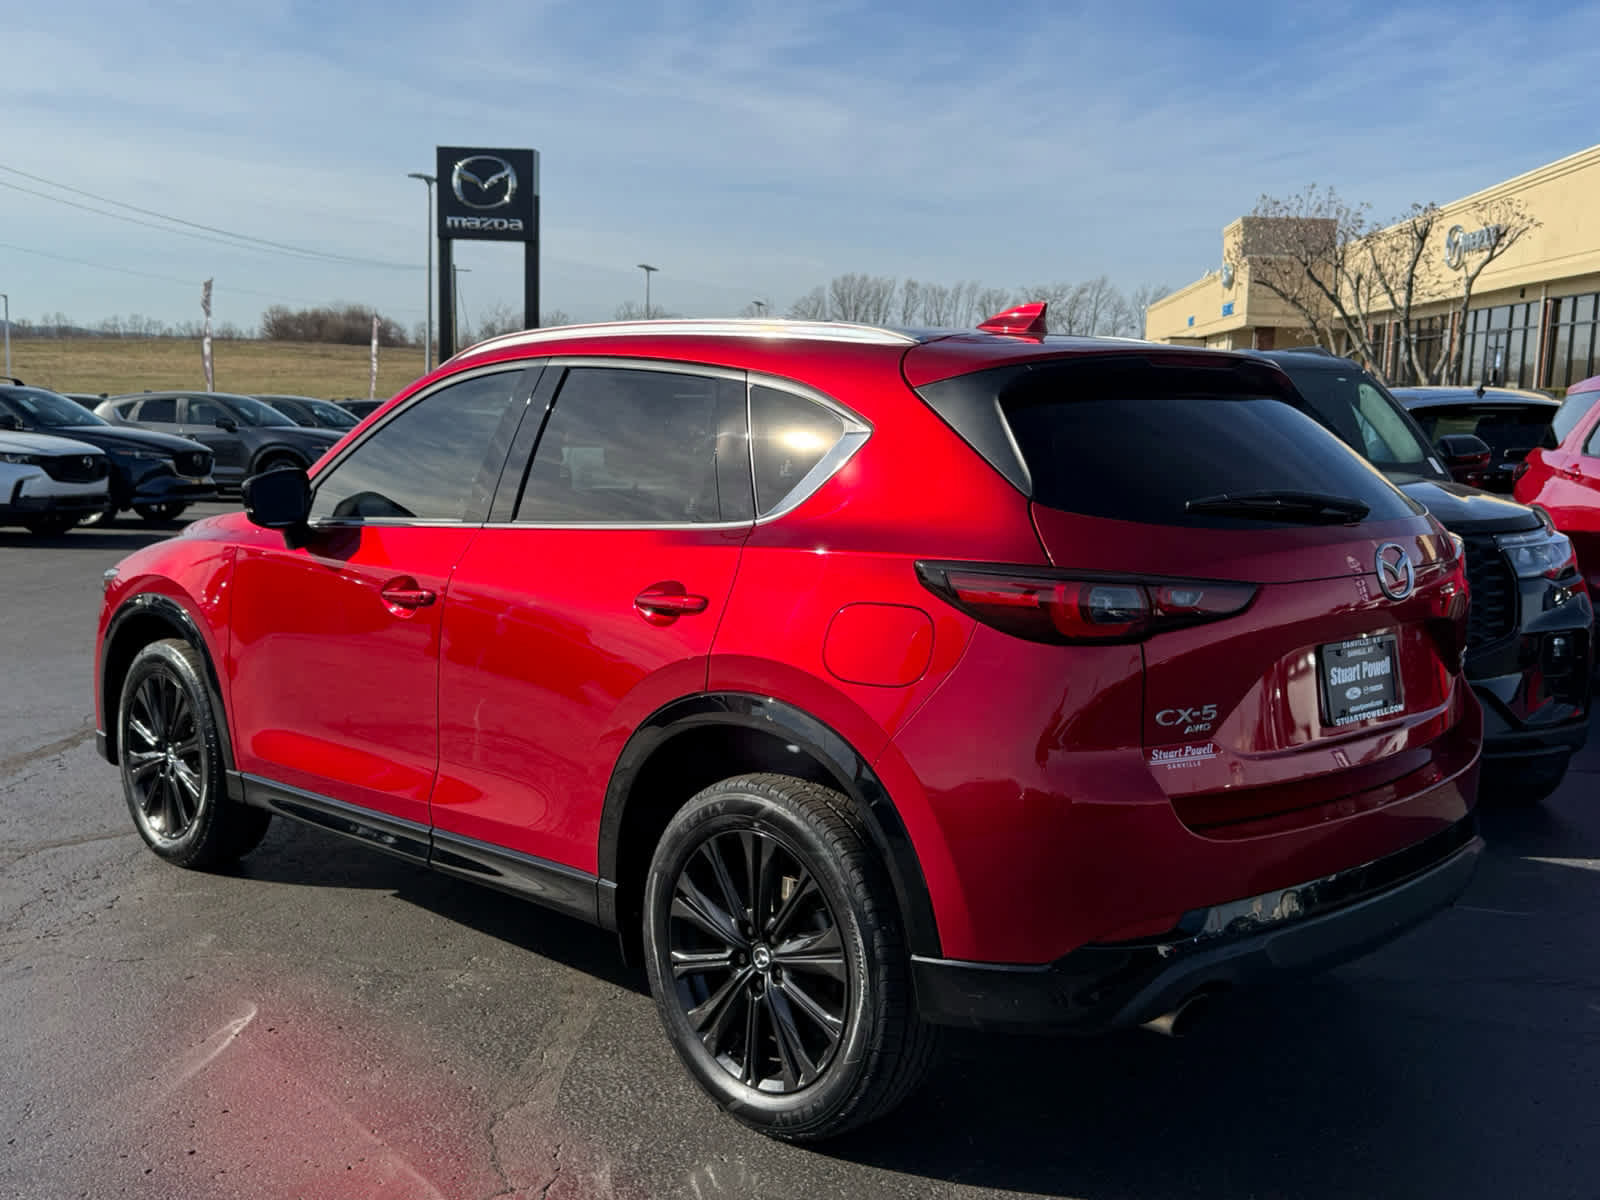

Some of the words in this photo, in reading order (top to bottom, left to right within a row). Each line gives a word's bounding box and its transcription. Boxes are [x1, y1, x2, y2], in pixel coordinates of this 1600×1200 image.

[446, 216, 523, 231] mazda
[1330, 664, 1361, 687] Stuart
[1362, 655, 1391, 679] Powell
[1155, 704, 1218, 727] CX-5
[1335, 704, 1405, 726] STUARTPOWELL.COM
[1183, 722, 1212, 735] AWD
[1151, 748, 1183, 761] Stuart
[1184, 743, 1214, 757] Powell
